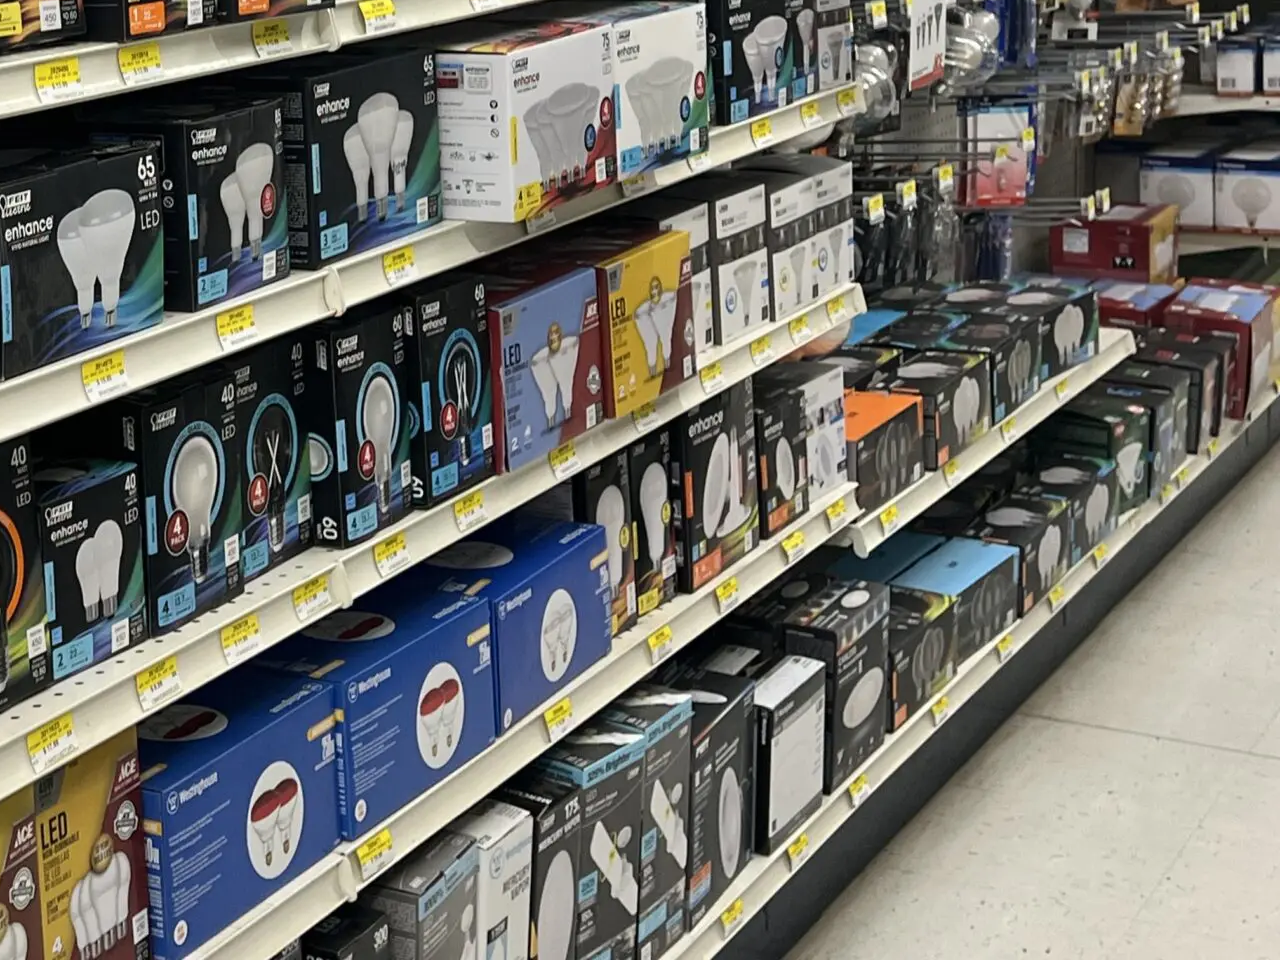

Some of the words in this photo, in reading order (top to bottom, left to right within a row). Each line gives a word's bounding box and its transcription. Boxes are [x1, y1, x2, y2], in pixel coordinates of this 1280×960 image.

[423, 54, 433, 72] 65
[513, 73, 540, 88] enhance
[317, 96, 350, 117] enhance
[424, 91, 435, 106] LED
[137, 155, 155, 181] 65
[5, 216, 53, 242] enhance
[141, 209, 160, 231] LED
[474, 283, 485, 300] 60
[610, 297, 626, 320] LED
[392, 314, 403, 332] 60
[422, 316, 447, 331] enhance
[291, 343, 302, 360] 40
[337, 351, 364, 368] enhance
[503, 342, 521, 368] LED
[221, 383, 235, 403] 40
[221, 425, 235, 440] LED
[688, 413, 724, 439] enhance
[10, 445, 27, 468] 40
[16, 492, 32, 508] LED
[124, 508, 139, 526] LED
[357, 668, 390, 694] Westinghouse
[118, 757, 138, 782] ACE
[178, 771, 218, 804] Westinghouse
[13, 821, 35, 847] ACE
[40, 813, 68, 849] LED
